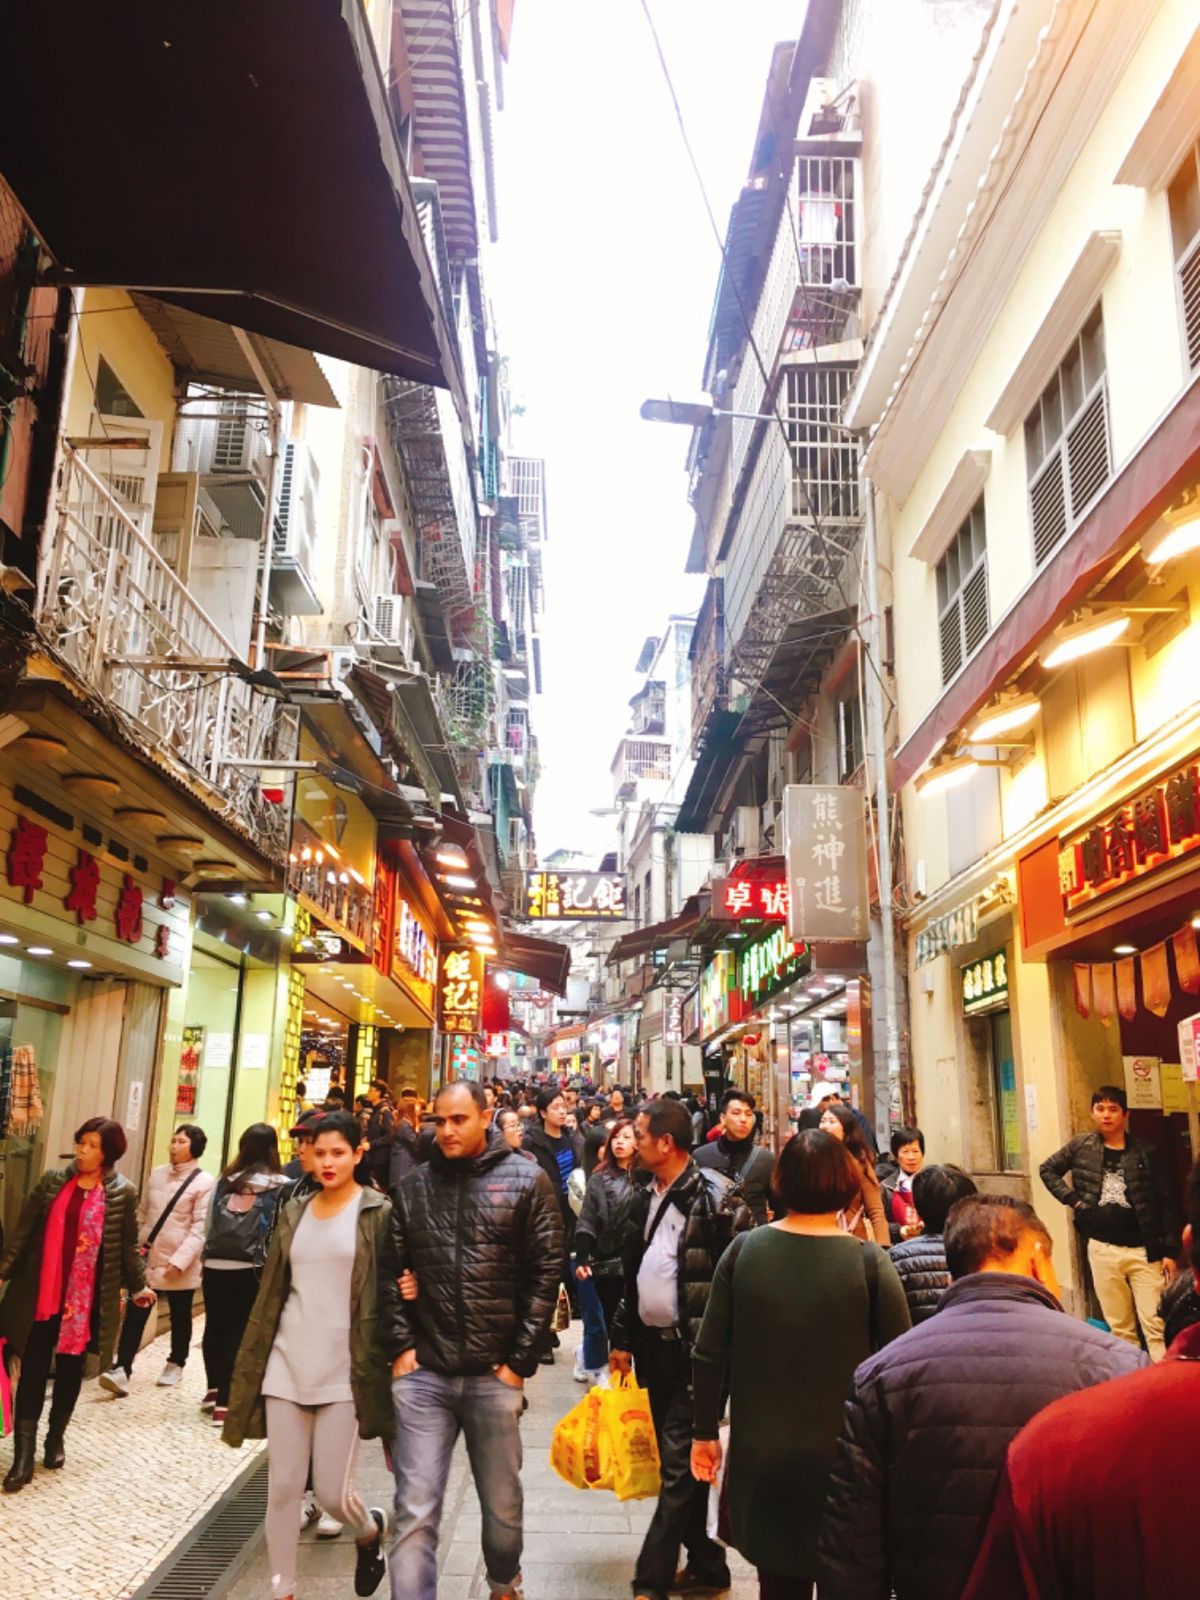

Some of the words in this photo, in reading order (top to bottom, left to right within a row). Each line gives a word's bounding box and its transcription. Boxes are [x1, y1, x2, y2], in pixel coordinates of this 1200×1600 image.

[811, 793, 847, 913] 熊神進
[559, 876, 625, 909] 鉅記
[442, 950, 472, 1010] 鉅記
